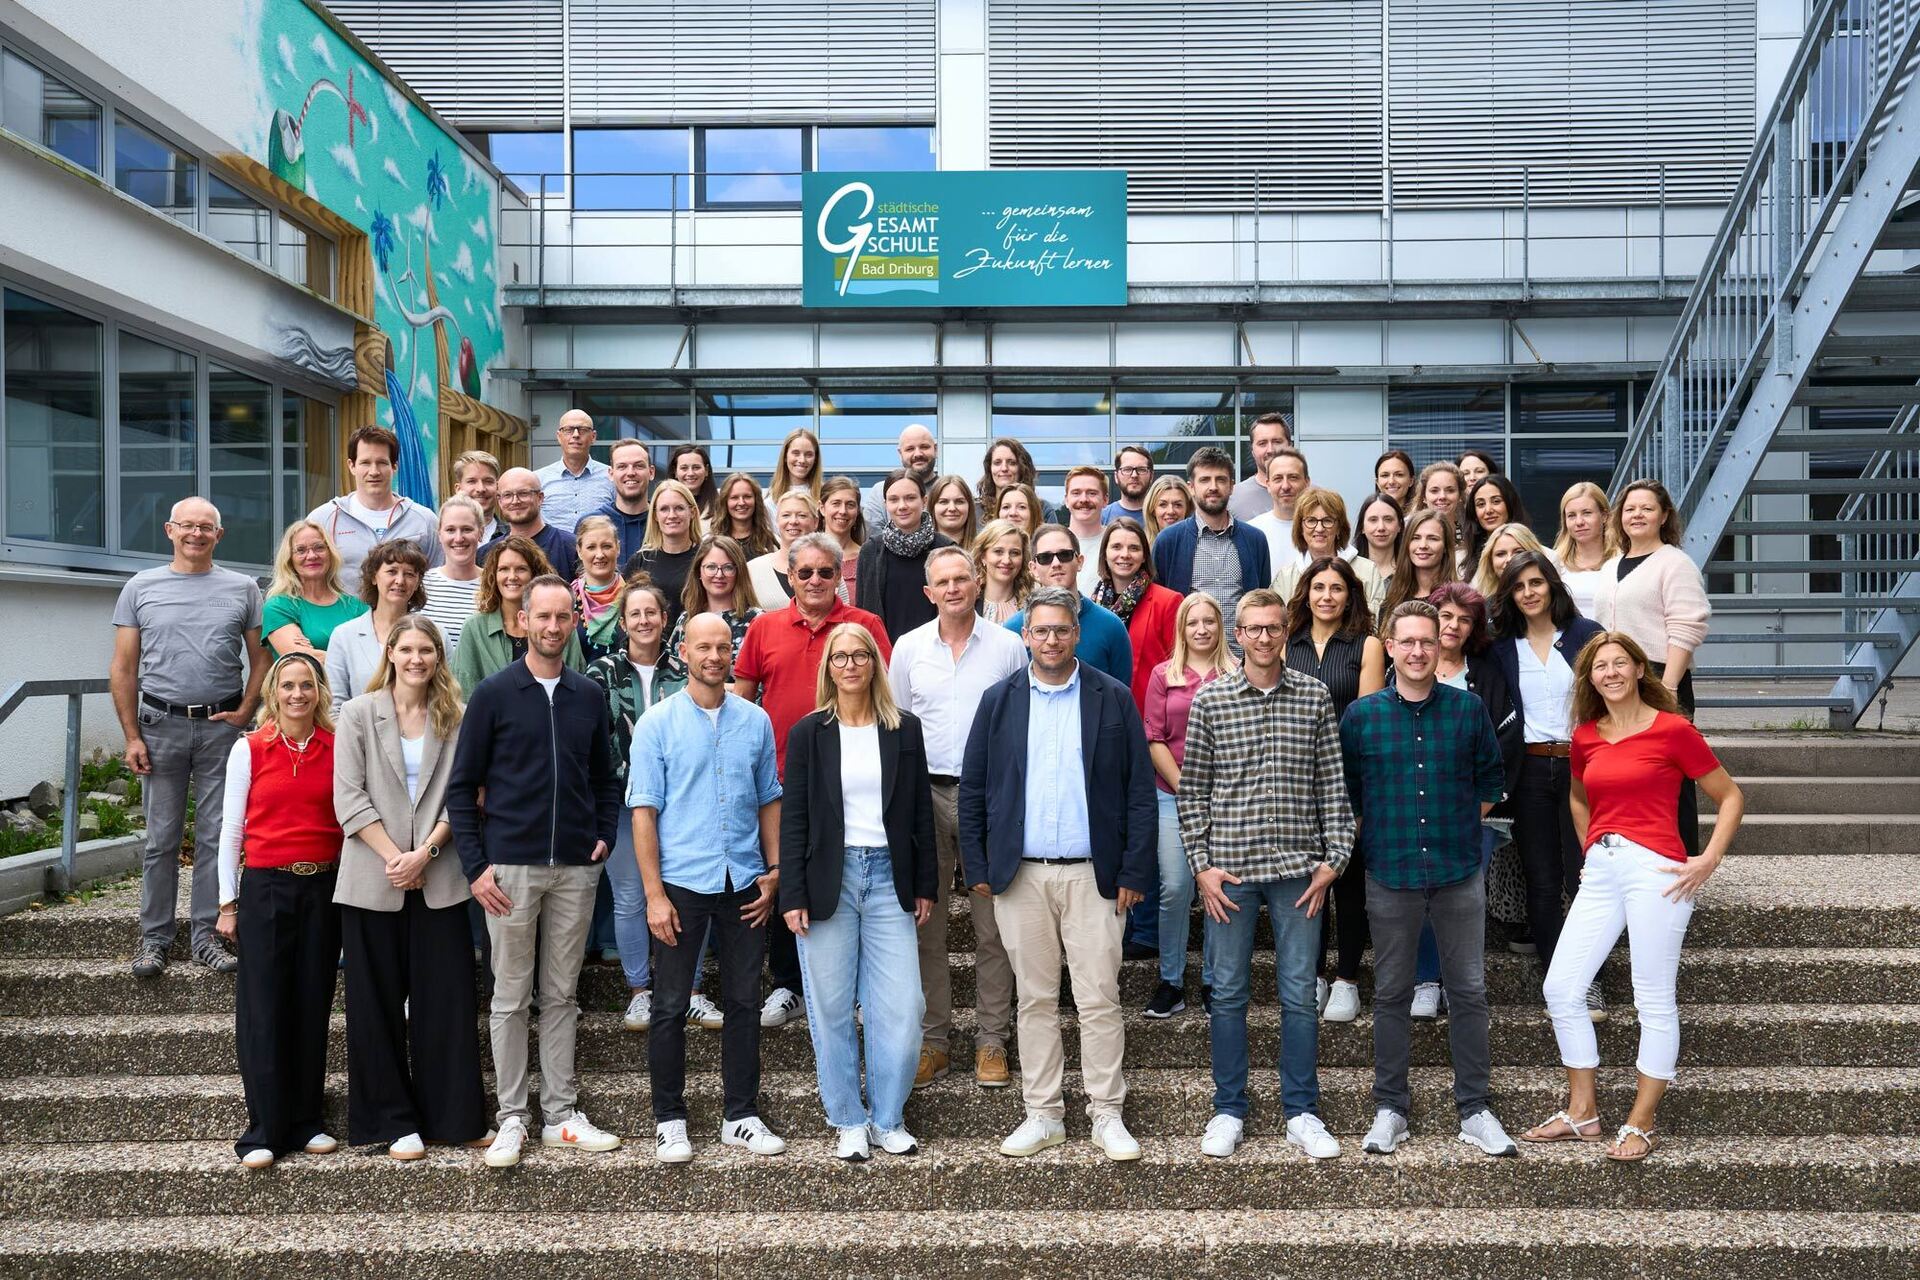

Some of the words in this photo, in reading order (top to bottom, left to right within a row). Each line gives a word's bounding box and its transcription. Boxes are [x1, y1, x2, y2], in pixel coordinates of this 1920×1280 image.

[878, 202, 939, 214] städtische
[996, 204, 1094, 229] gemeinsam
[878, 217, 939, 233] ESAMT
[1003, 223, 1038, 249] für
[1043, 222, 1069, 243] die
[868, 237, 939, 252] SCHULE
[862, 263, 884, 275] Bad
[890, 263, 934, 277] Driburg
[952, 248, 1062, 278] Zukunft
[1063, 247, 1113, 269] lernen
